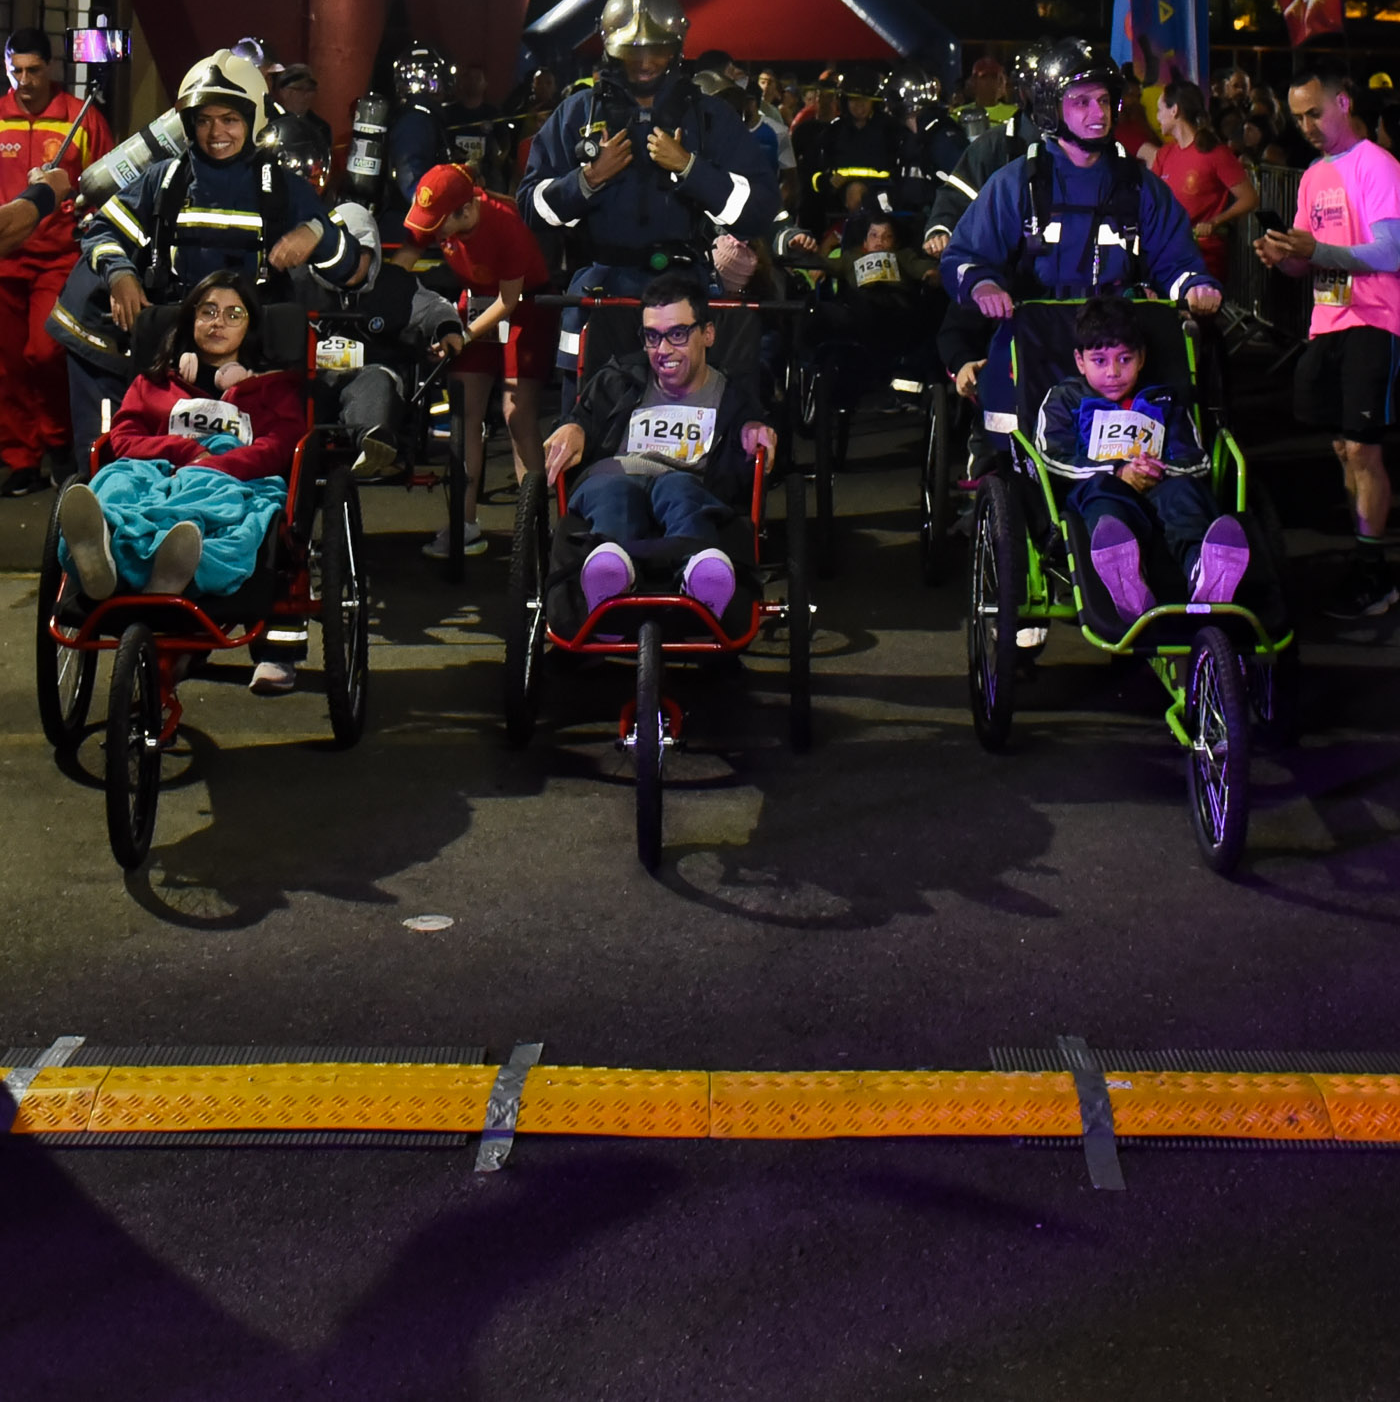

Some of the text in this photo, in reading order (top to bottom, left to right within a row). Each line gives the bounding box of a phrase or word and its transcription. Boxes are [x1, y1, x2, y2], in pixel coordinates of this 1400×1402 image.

[178, 410, 241, 436] 1245
[639, 418, 702, 441] 1246
[1098, 423, 1154, 444] 1247
